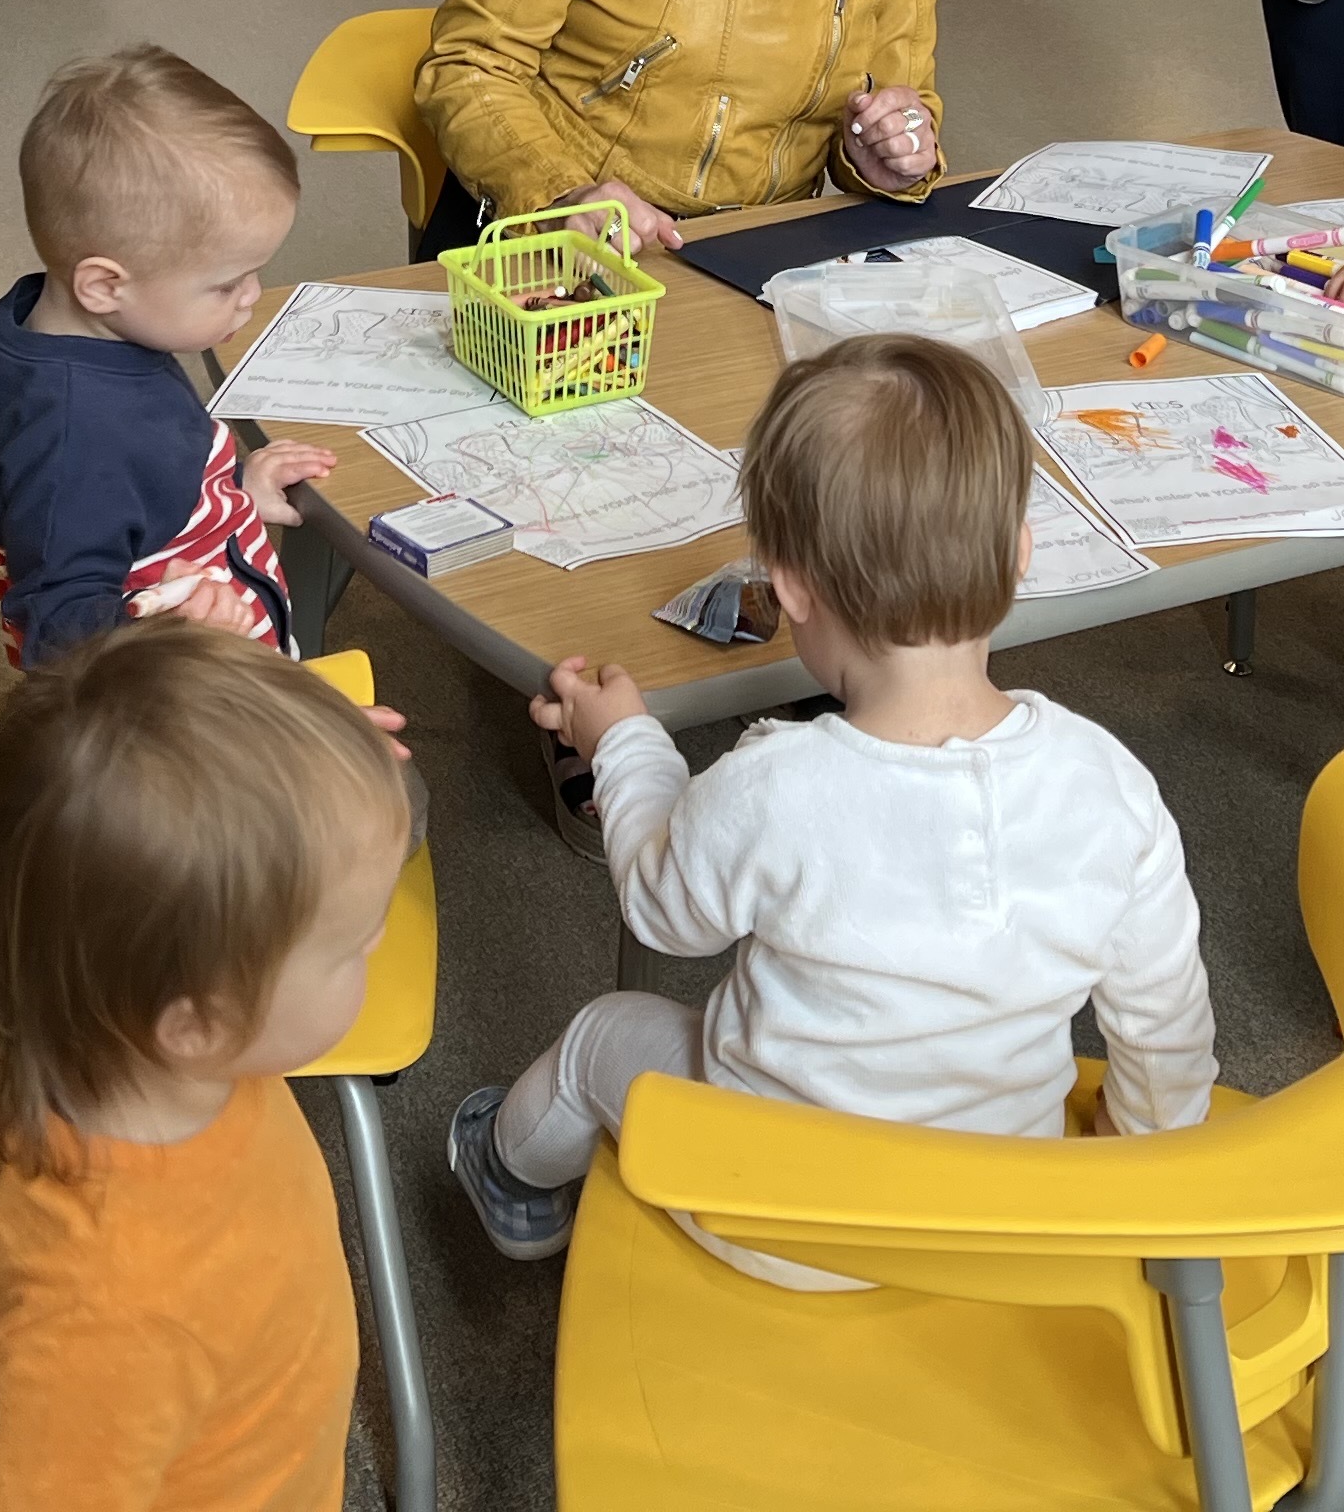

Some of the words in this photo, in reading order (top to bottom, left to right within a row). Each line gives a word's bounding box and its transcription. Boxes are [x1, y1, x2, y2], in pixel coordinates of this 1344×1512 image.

[396, 307, 444, 317] KIDS
[247, 375, 285, 384] What
[287, 378, 325, 387] color
[344, 381, 384, 390] YOUR
[1131, 400, 1184, 410] KIDS
